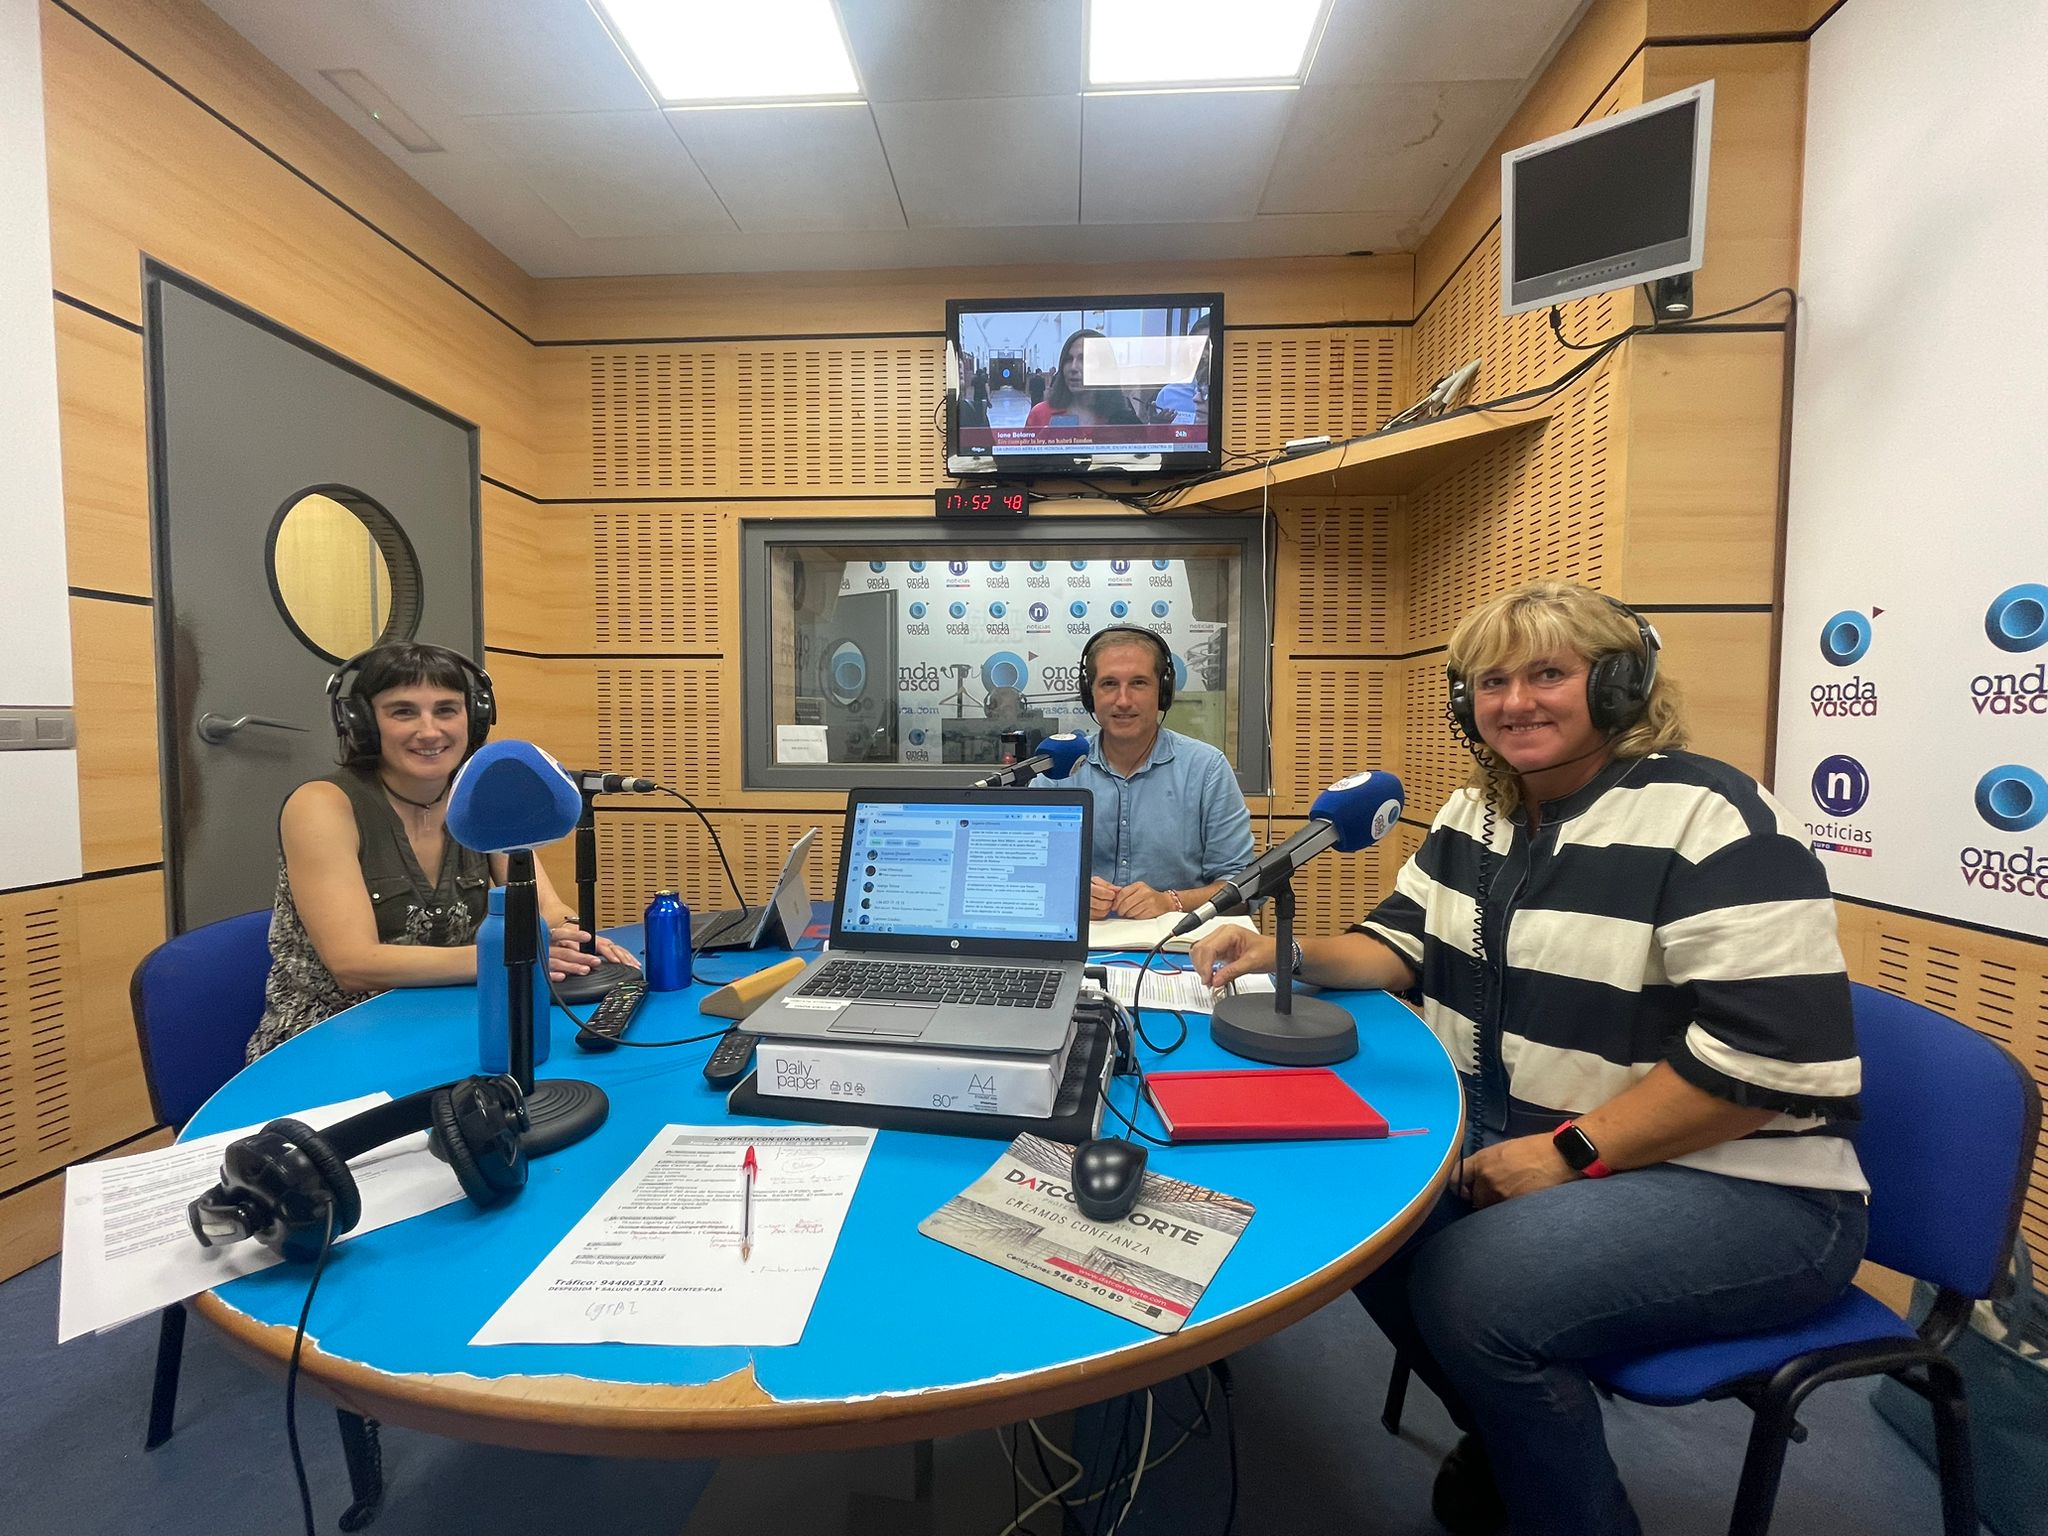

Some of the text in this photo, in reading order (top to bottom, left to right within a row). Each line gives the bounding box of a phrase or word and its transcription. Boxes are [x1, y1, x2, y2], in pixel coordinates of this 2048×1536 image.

[1003, 494, 1023, 510] 48
[866, 576, 889, 585] onda
[906, 576, 929, 585] onda
[986, 576, 1009, 584] onda
[1026, 575, 1049, 584] onda
[1067, 575, 1090, 583] onda
[1149, 574, 1172, 583] onda
[907, 622, 929, 631] onda
[946, 622, 969, 631] onda
[986, 622, 1009, 631] onda
[1067, 621, 1090, 630] onda
[899, 662, 939, 680] nda
[1042, 661, 1081, 680] ond
[899, 679, 939, 691] asca
[1810, 675, 1877, 701] onda
[1970, 664, 2048, 696] ond
[1811, 699, 1877, 717] vasca
[1971, 694, 2048, 715] vasc
[1805, 822, 1872, 843] noticias
[776, 1059, 812, 1079] Daily
[777, 1075, 821, 1091] paper
[967, 1073, 997, 1095] A4
[932, 1094, 951, 1108] 80
[1004, 1169, 1204, 1246] DATCO ORTE
[1005, 1197, 1151, 1256] CREAMOS CONFIANZA
[1074, 1279, 1089, 1289] 55
[1090, 1285, 1106, 1296] 40
